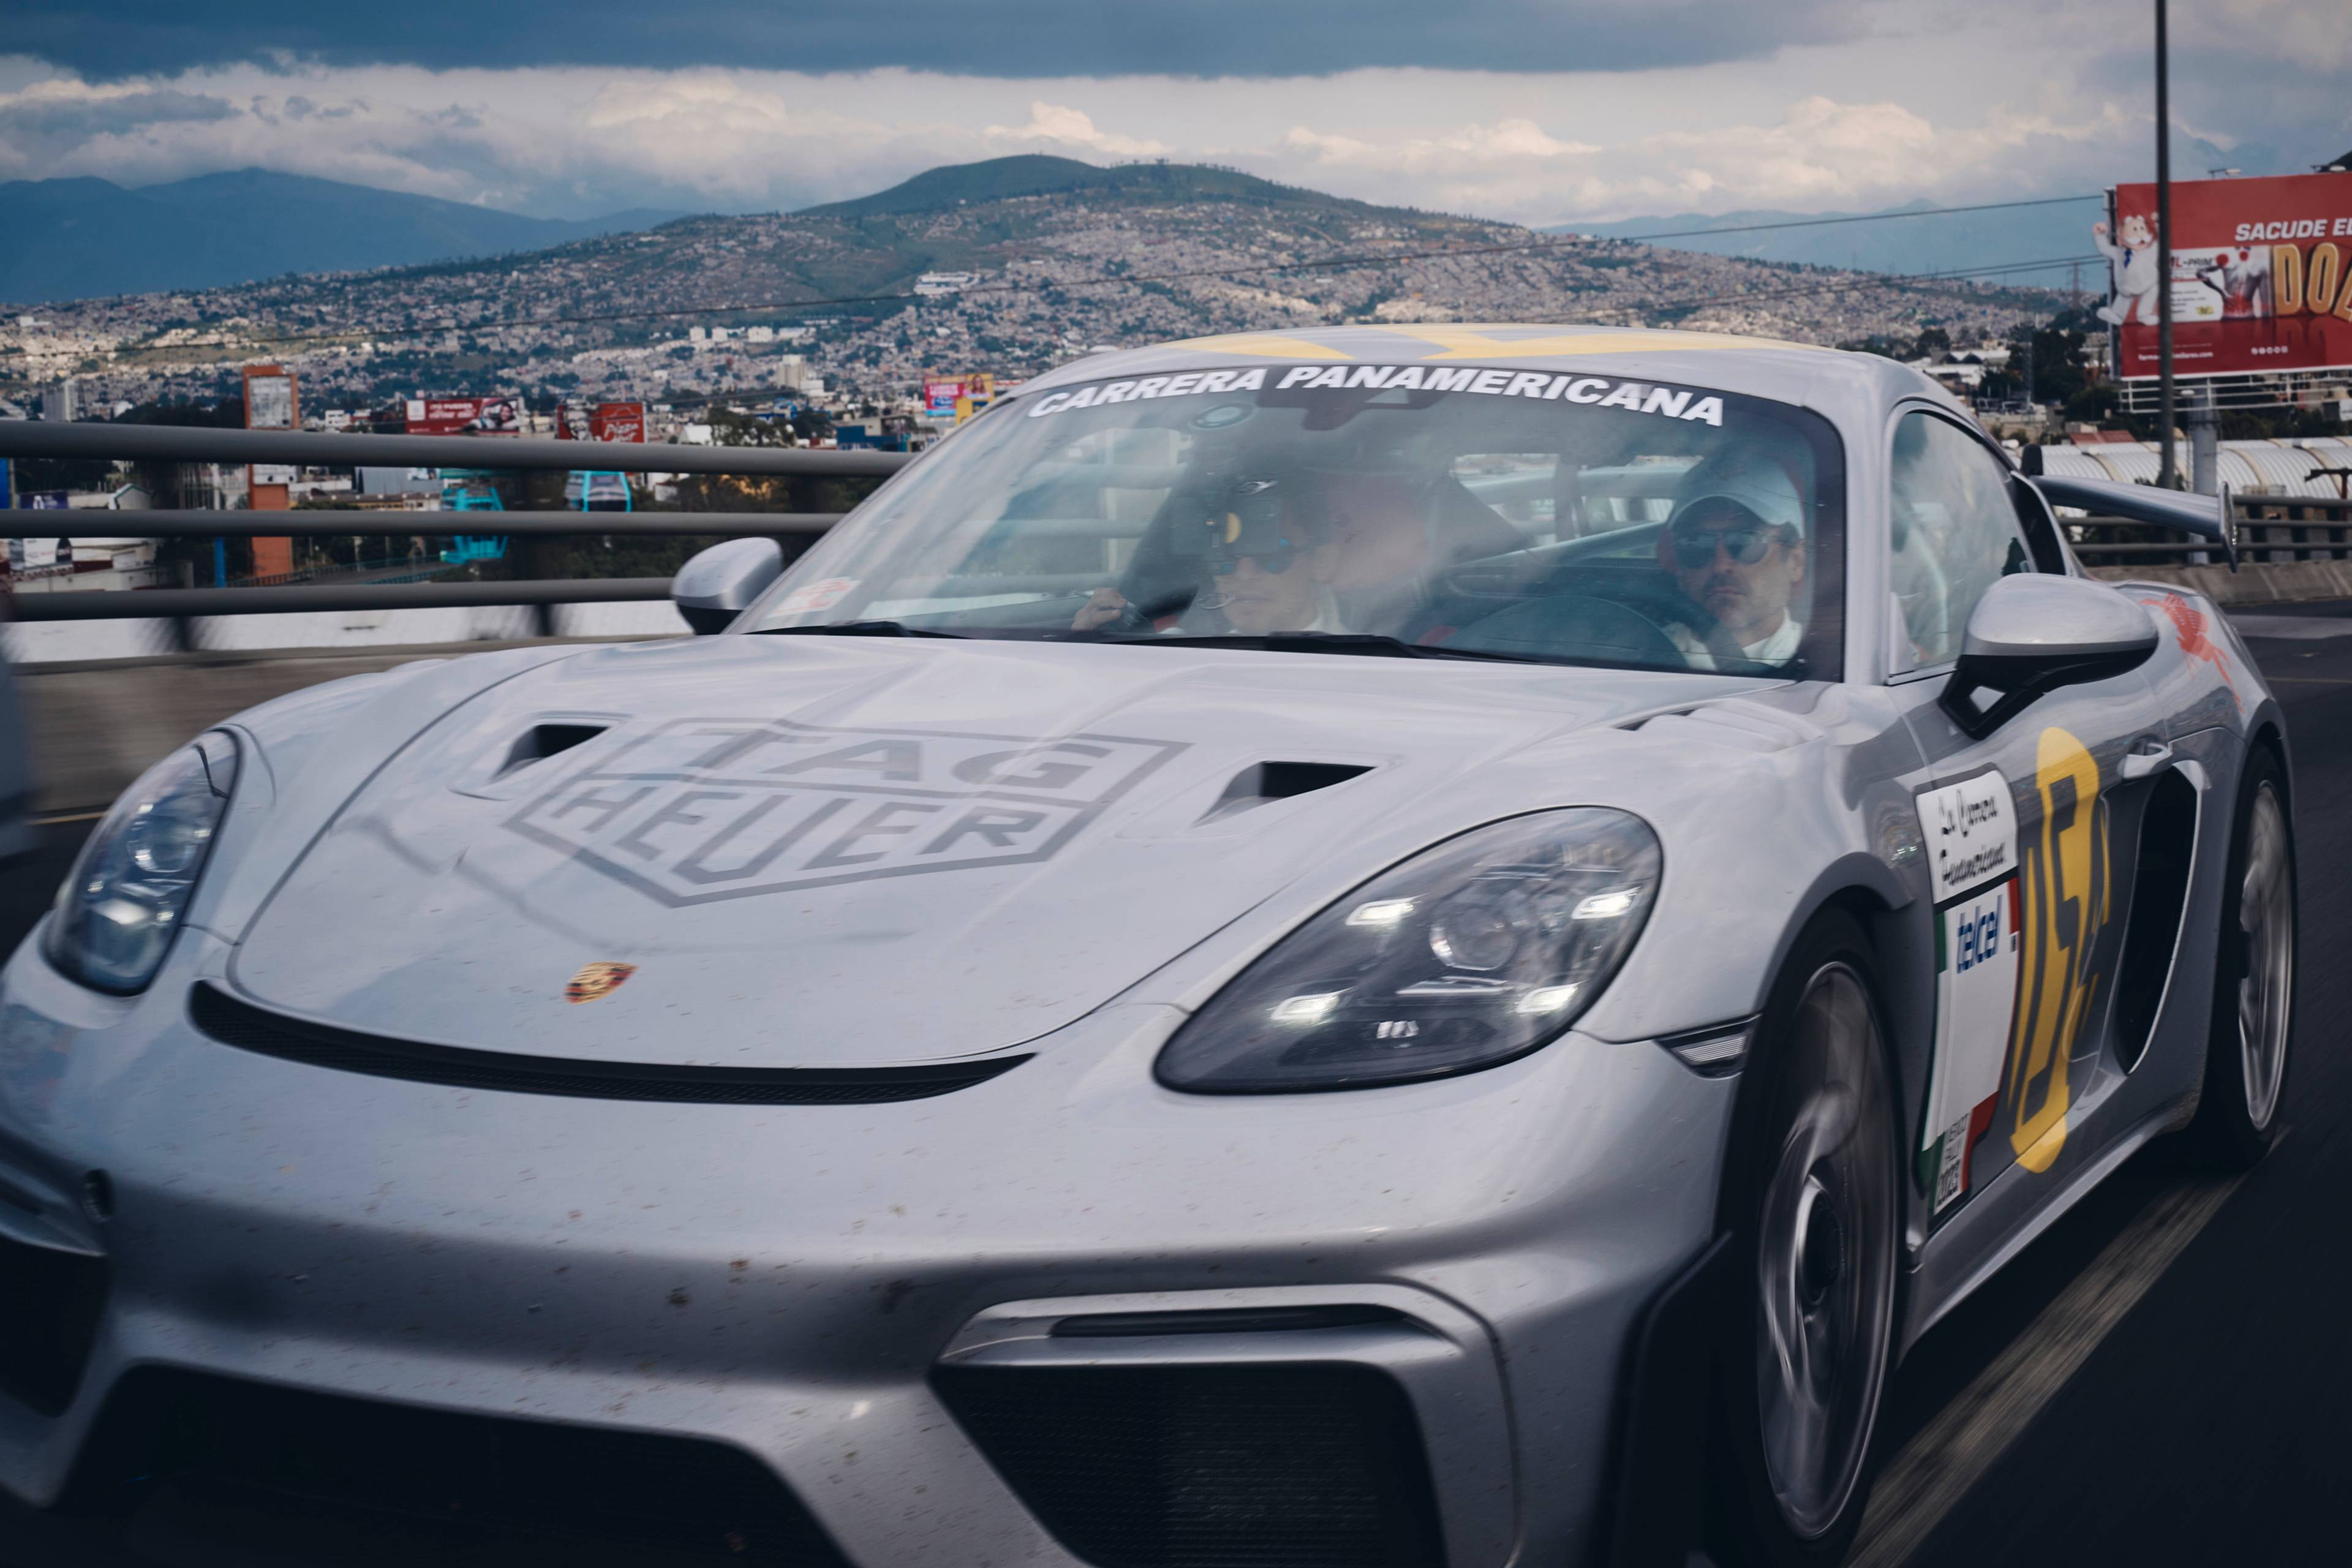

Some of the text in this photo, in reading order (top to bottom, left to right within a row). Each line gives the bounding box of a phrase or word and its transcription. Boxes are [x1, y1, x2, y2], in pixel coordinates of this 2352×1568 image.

[2235, 219, 2328, 241] SACUDE
[1027, 366, 1724, 426] CARRERA PANAMERICANA
[682, 728, 1113, 789] TAG
[548, 786, 1055, 885] HEUER
[1956, 894, 2003, 974] telcel
